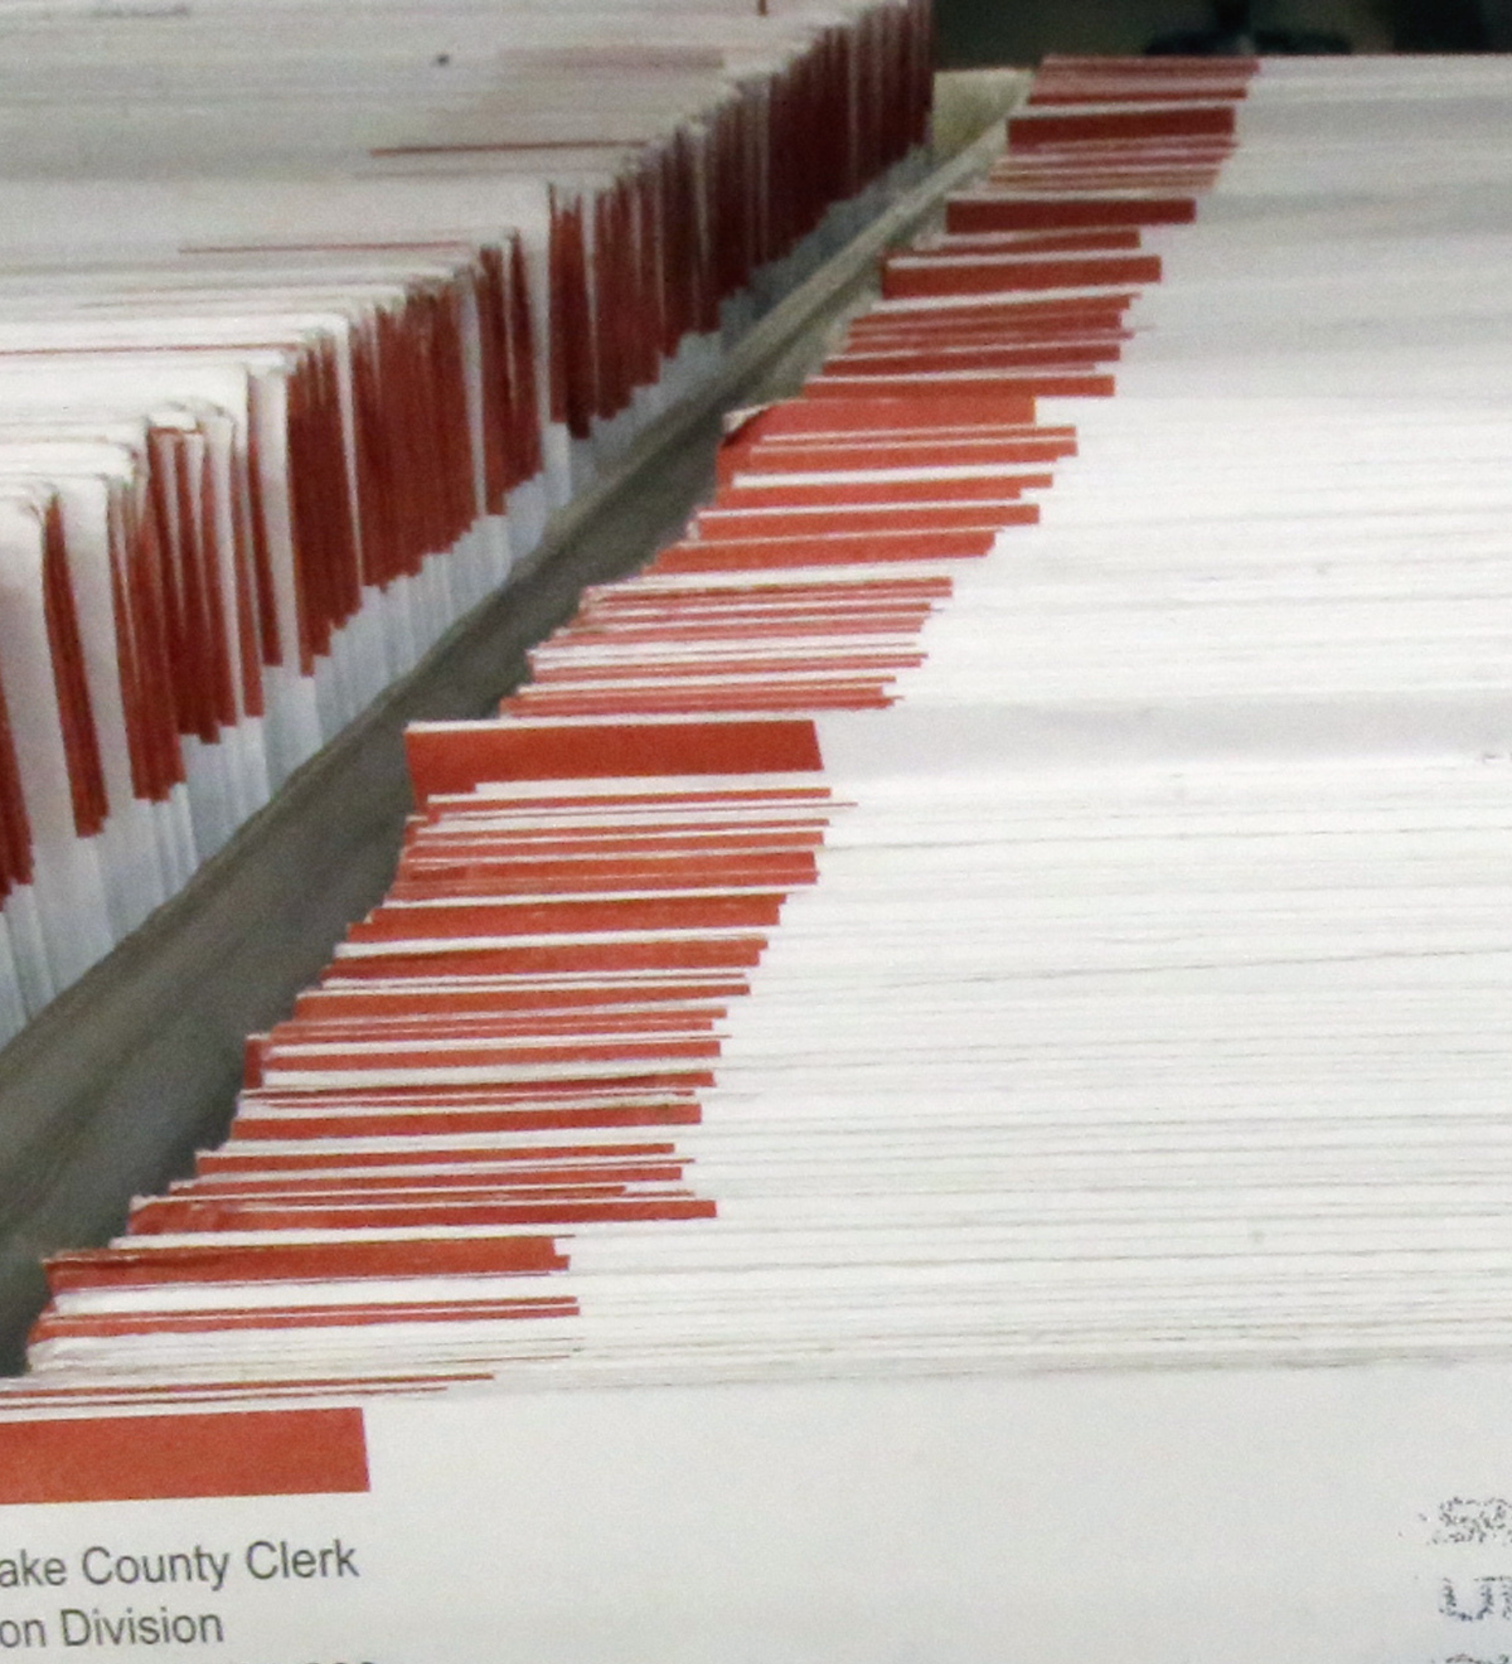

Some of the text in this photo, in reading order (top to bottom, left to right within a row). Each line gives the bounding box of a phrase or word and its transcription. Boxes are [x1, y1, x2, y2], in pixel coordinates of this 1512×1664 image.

[81, 1545, 230, 1592] County
[245, 1538, 360, 1581] Clerk
[59, 1606, 224, 1647] Division
